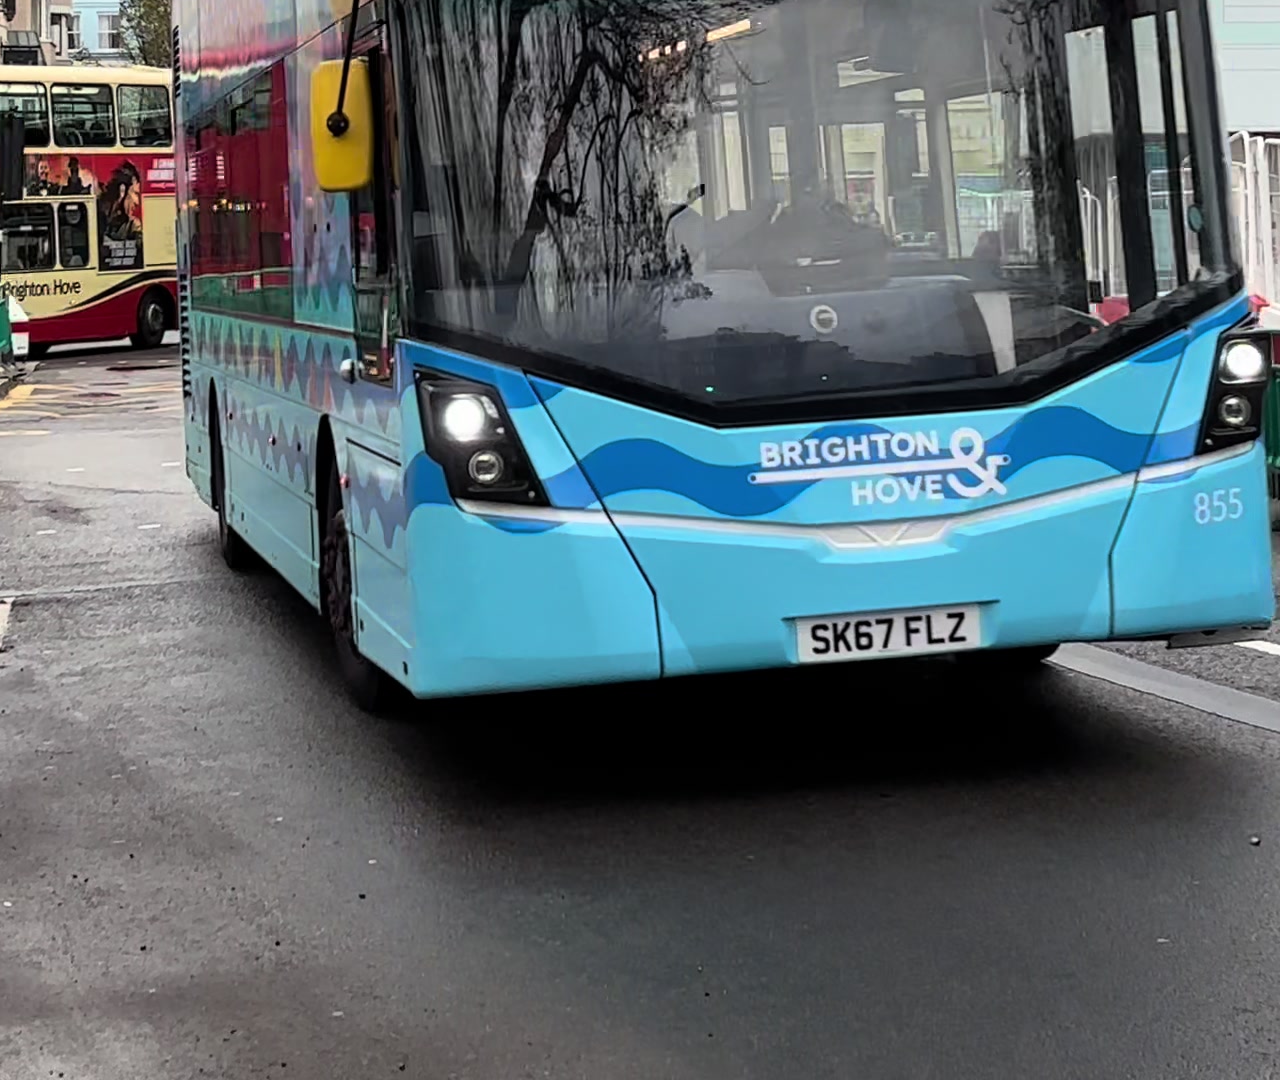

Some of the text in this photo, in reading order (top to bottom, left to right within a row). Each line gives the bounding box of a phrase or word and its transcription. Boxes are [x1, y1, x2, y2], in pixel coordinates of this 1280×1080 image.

[53, 278, 81, 296] Hove
[760, 430, 940, 469] BRIGHTON
[851, 474, 945, 506] HOVE
[1194, 487, 1244, 525] 855
[811, 612, 967, 655] SK67 FLZ
